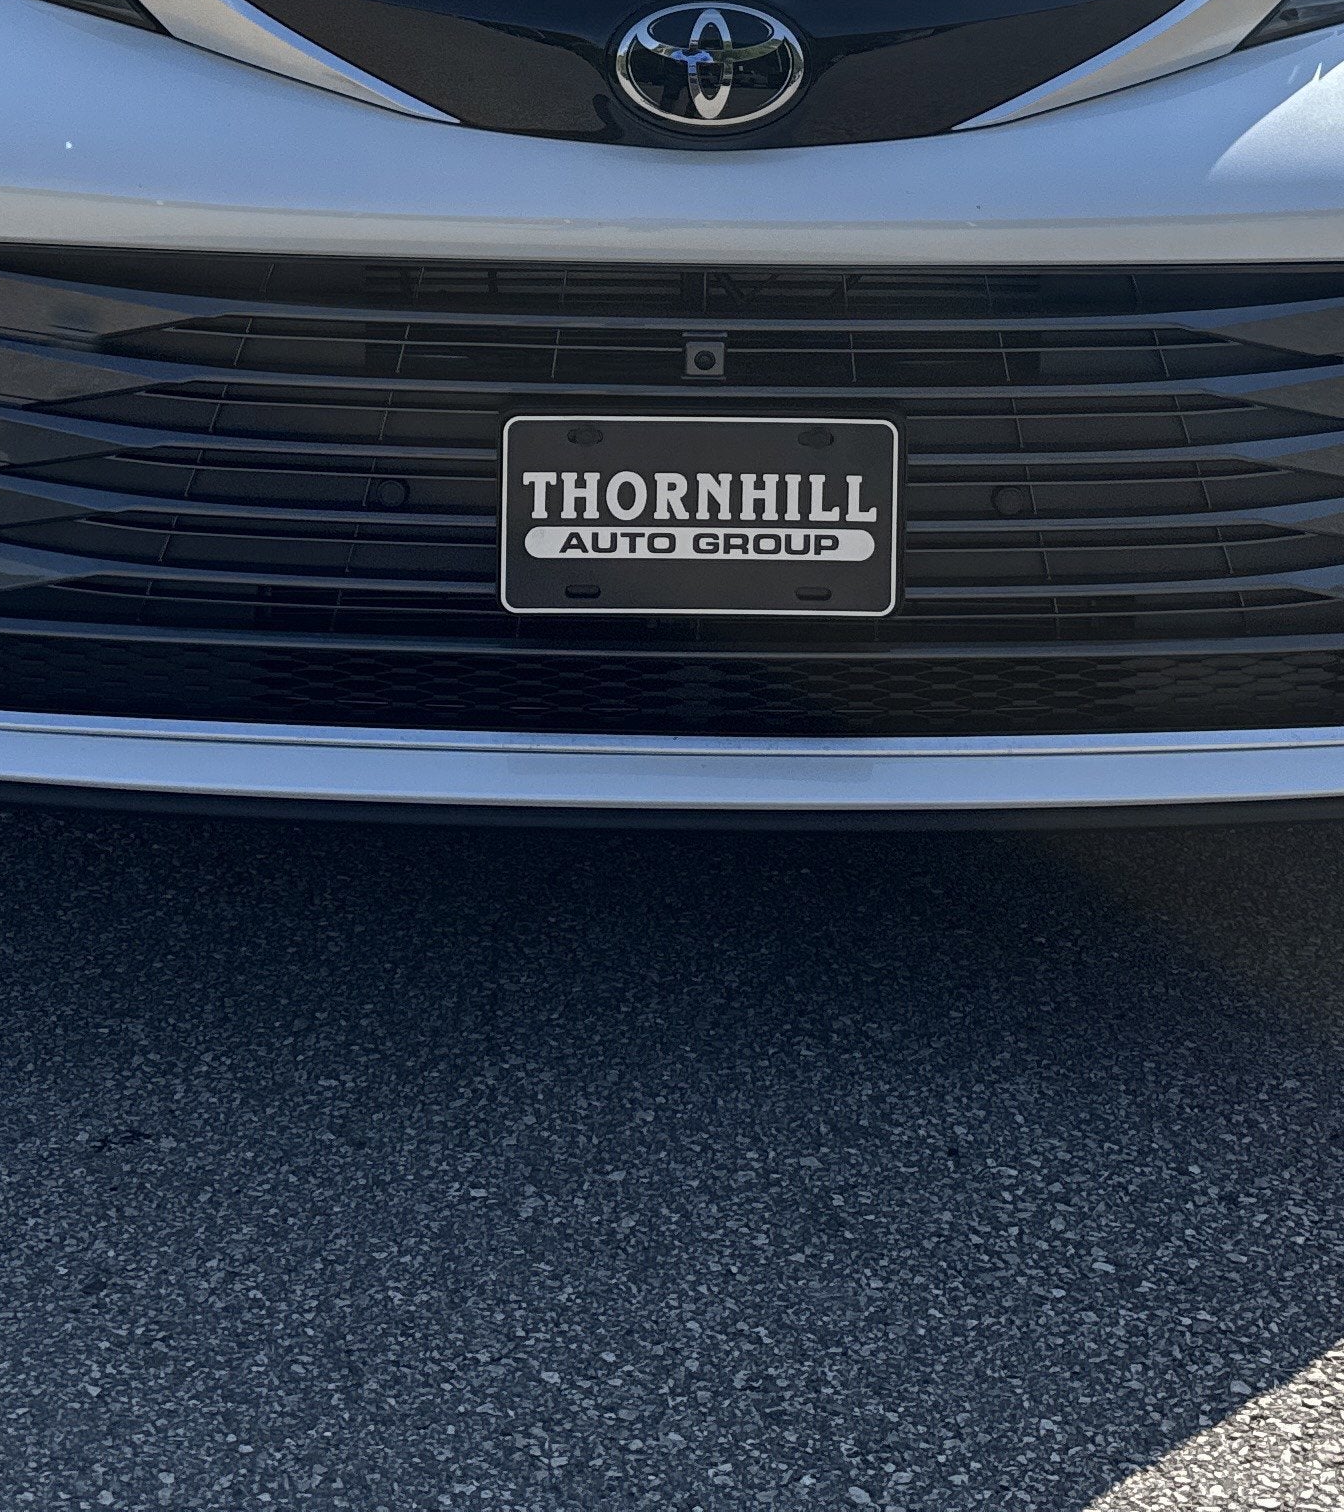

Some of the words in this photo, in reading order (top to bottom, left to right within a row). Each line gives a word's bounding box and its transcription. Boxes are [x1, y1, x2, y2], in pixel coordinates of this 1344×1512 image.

[522, 471, 878, 523] THORNHILL
[559, 531, 676, 554] AUTO
[693, 532, 840, 556] GROUP
